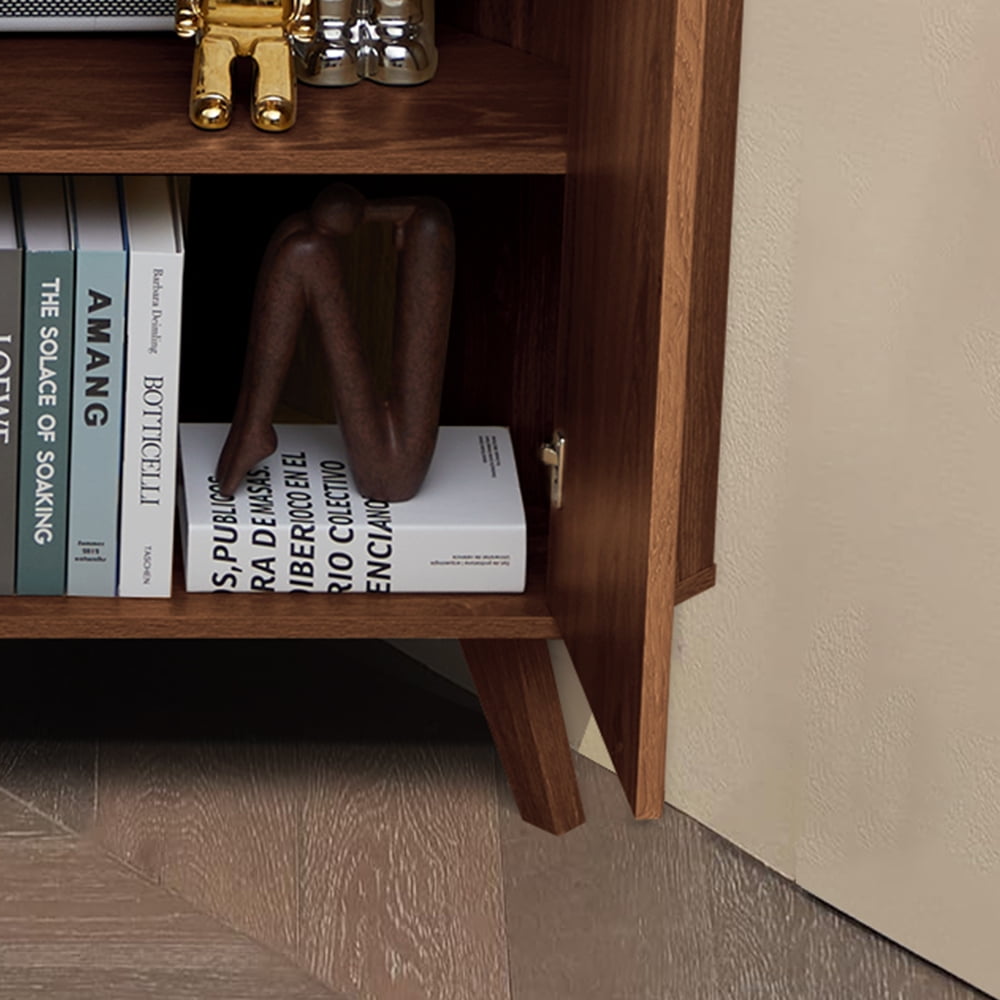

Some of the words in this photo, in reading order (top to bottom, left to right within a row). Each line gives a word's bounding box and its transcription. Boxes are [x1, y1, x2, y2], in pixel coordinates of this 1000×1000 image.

[40, 277, 60, 318] THE
[152, 268, 164, 308] Barbara
[149, 309, 162, 355] Deimling
[37, 326, 59, 406] SOLACE
[84, 289, 112, 427] AMANG
[37, 413, 57, 443] OF
[140, 376, 164, 505] BOTTICELLI
[281, 451, 308, 468] EL
[283, 470, 310, 489] EN
[33, 450, 55, 545] SOAKING
[320, 460, 354, 544] COLECTIVO
[251, 518, 277, 548] DE
[286, 491, 315, 592] IBERIOCO
[362, 495, 393, 592] ENCIANO
[143, 546, 152, 585] TASCHEN
[211, 567, 242, 592] S,
